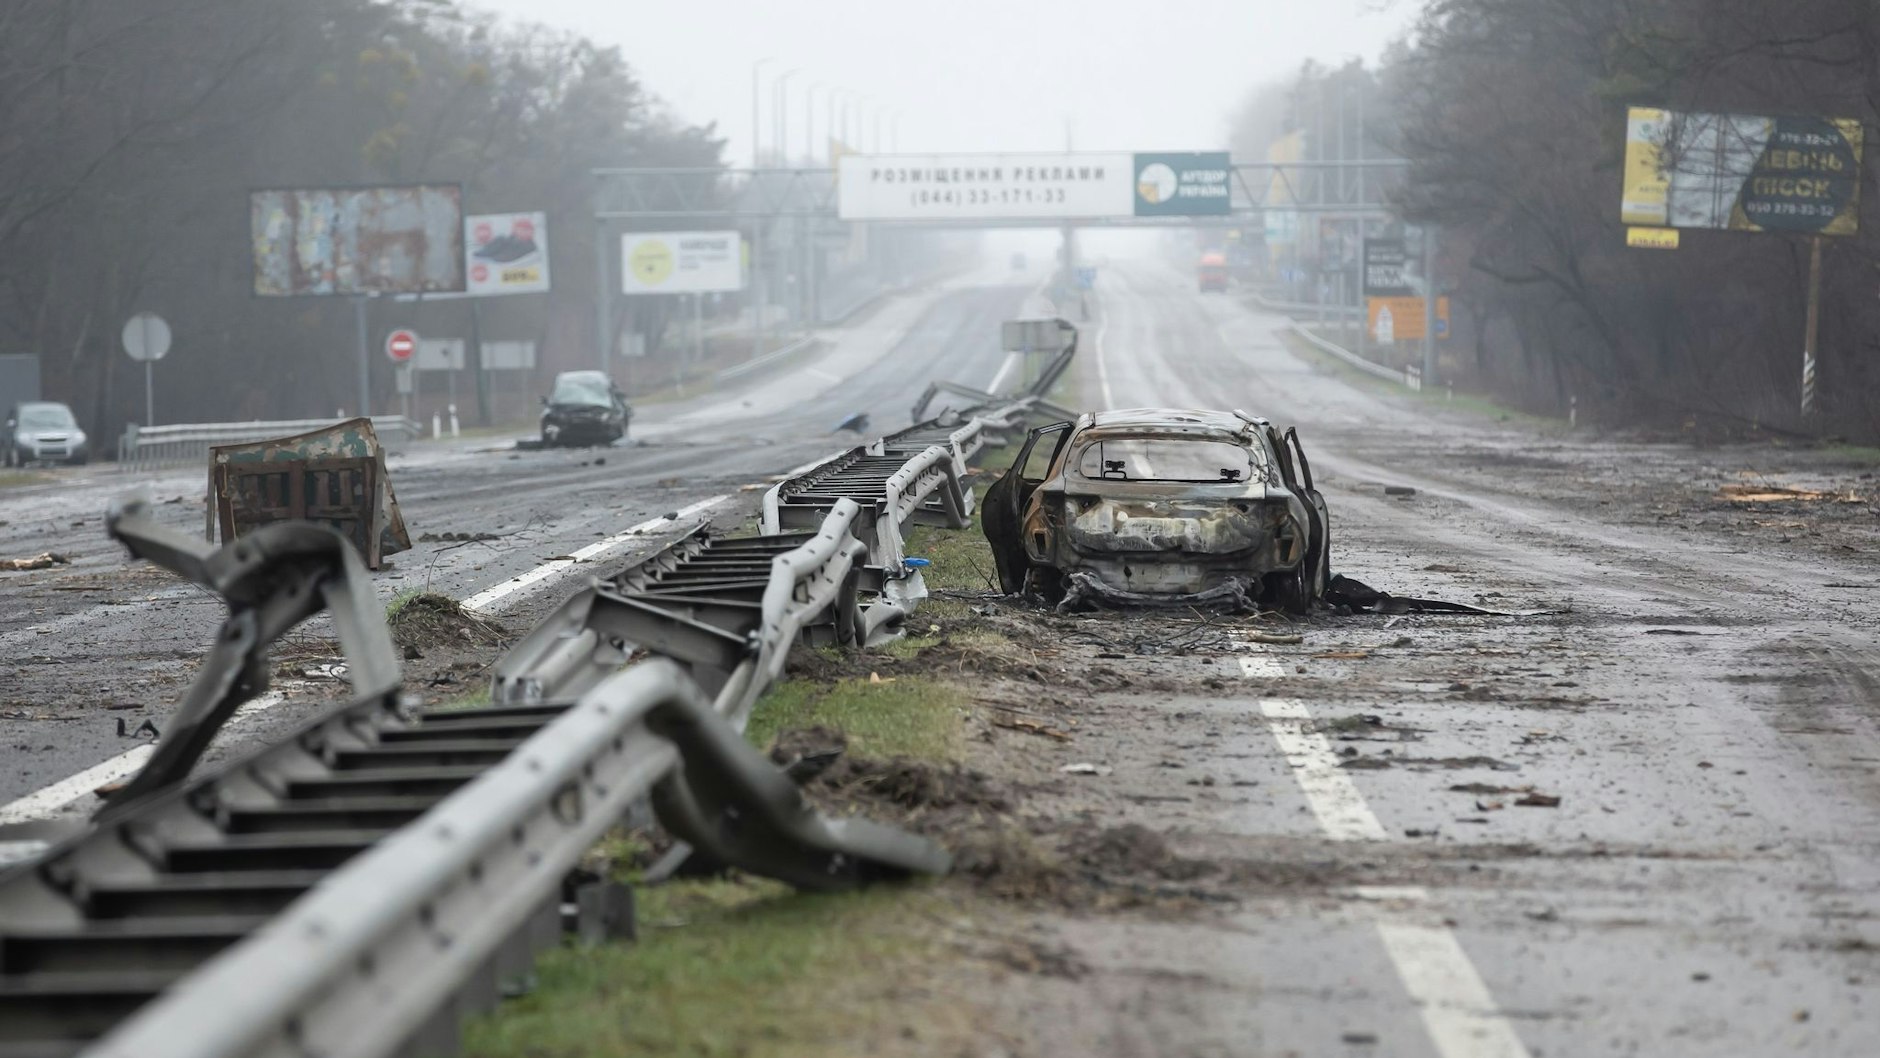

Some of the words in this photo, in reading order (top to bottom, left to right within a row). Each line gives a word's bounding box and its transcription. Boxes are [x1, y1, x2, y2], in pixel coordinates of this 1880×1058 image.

[870, 168, 1003, 183] РОЗМІЩЕННЯ
[1013, 166, 1106, 181] РЕКЛАМИ
[910, 189, 962, 207] (044)
[968, 188, 1066, 204] 33-171-33
